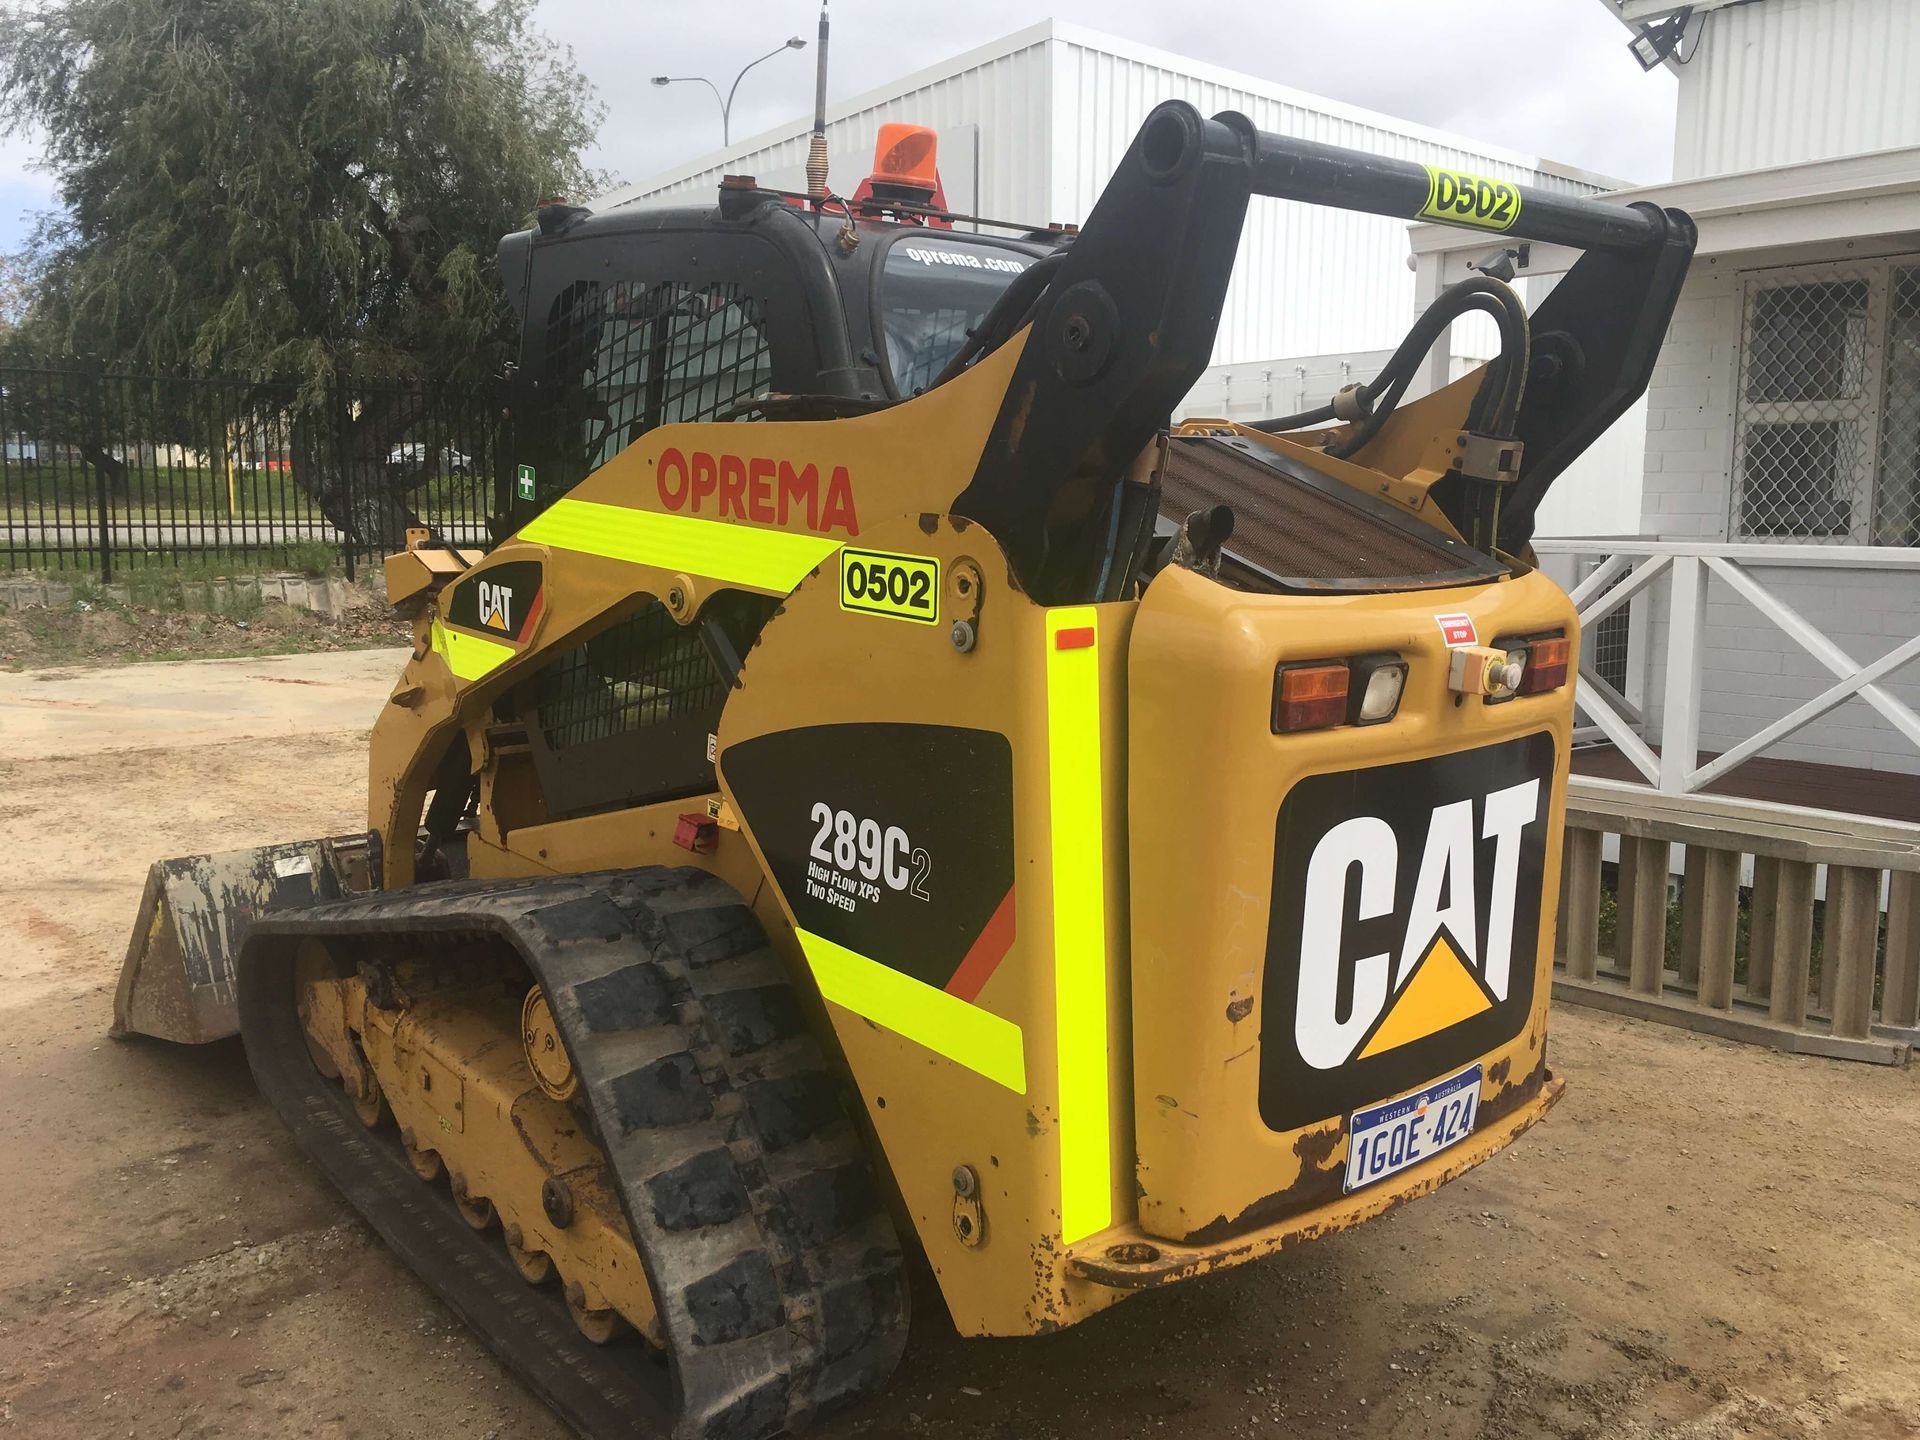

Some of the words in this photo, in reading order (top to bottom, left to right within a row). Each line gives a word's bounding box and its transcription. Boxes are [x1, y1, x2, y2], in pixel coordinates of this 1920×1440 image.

[1437, 172, 1514, 221] 0502
[906, 247, 1032, 273] oprema.com
[656, 447, 859, 537] OPREMA
[478, 580, 513, 632] CAT
[846, 561, 931, 609] 0502
[857, 881, 881, 903] XPS
[1294, 777, 1540, 1070] CAT
[1379, 1106, 1412, 1123] WESTERN
[1434, 1083, 1462, 1100] AUSTRALIA
